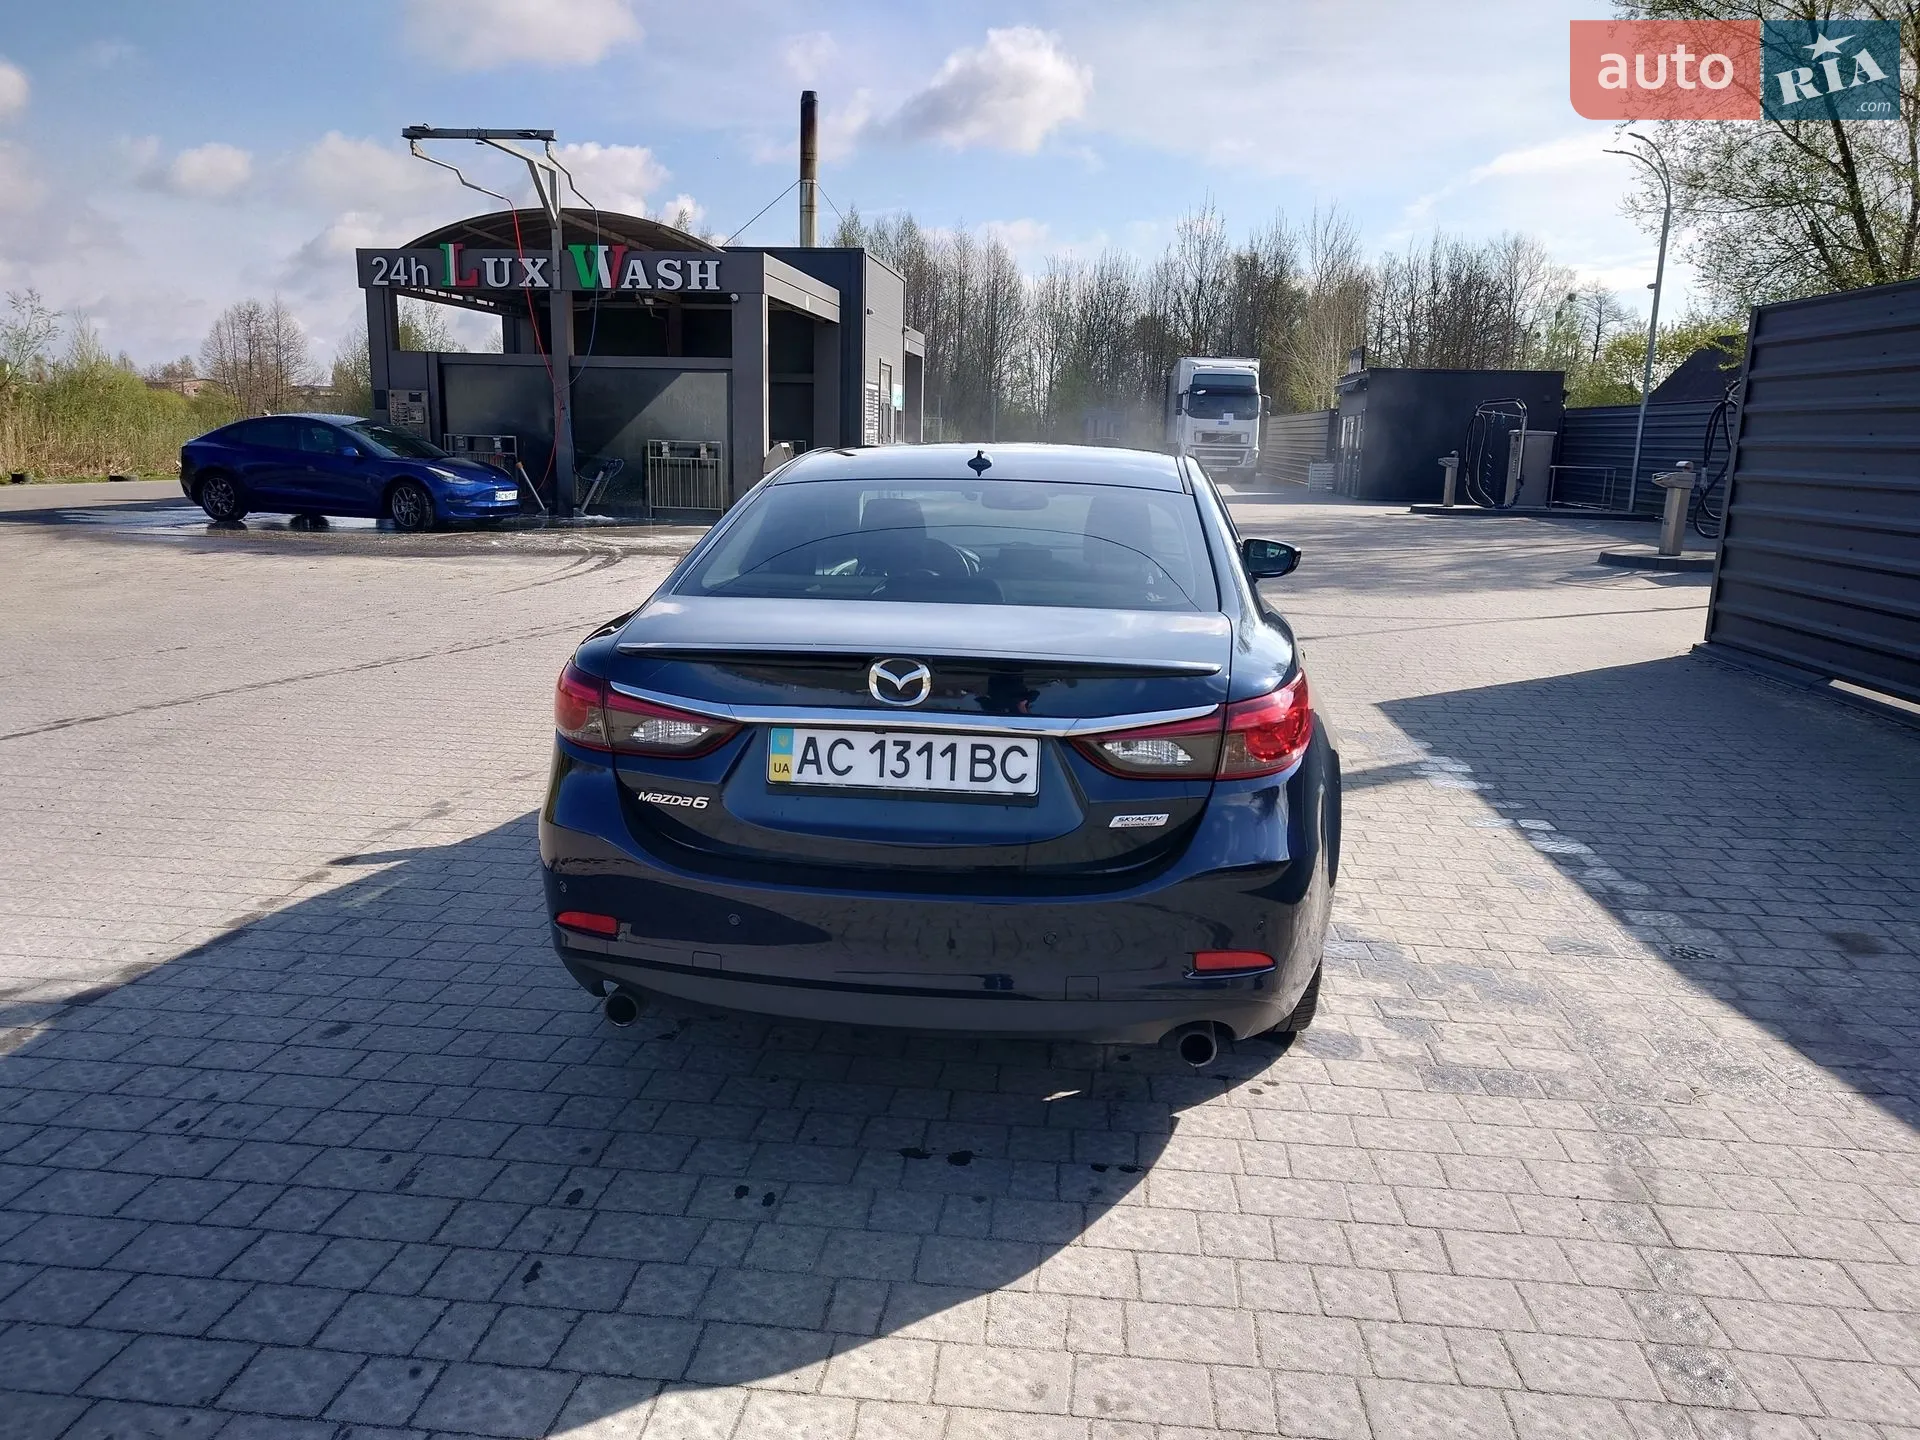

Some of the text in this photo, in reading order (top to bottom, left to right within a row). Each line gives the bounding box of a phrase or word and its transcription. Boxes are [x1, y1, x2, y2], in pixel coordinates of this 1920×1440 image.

[371, 256, 430, 287] 24h
[773, 762, 790, 774] UA
[796, 736, 1029, 784] AC 1311 BC
